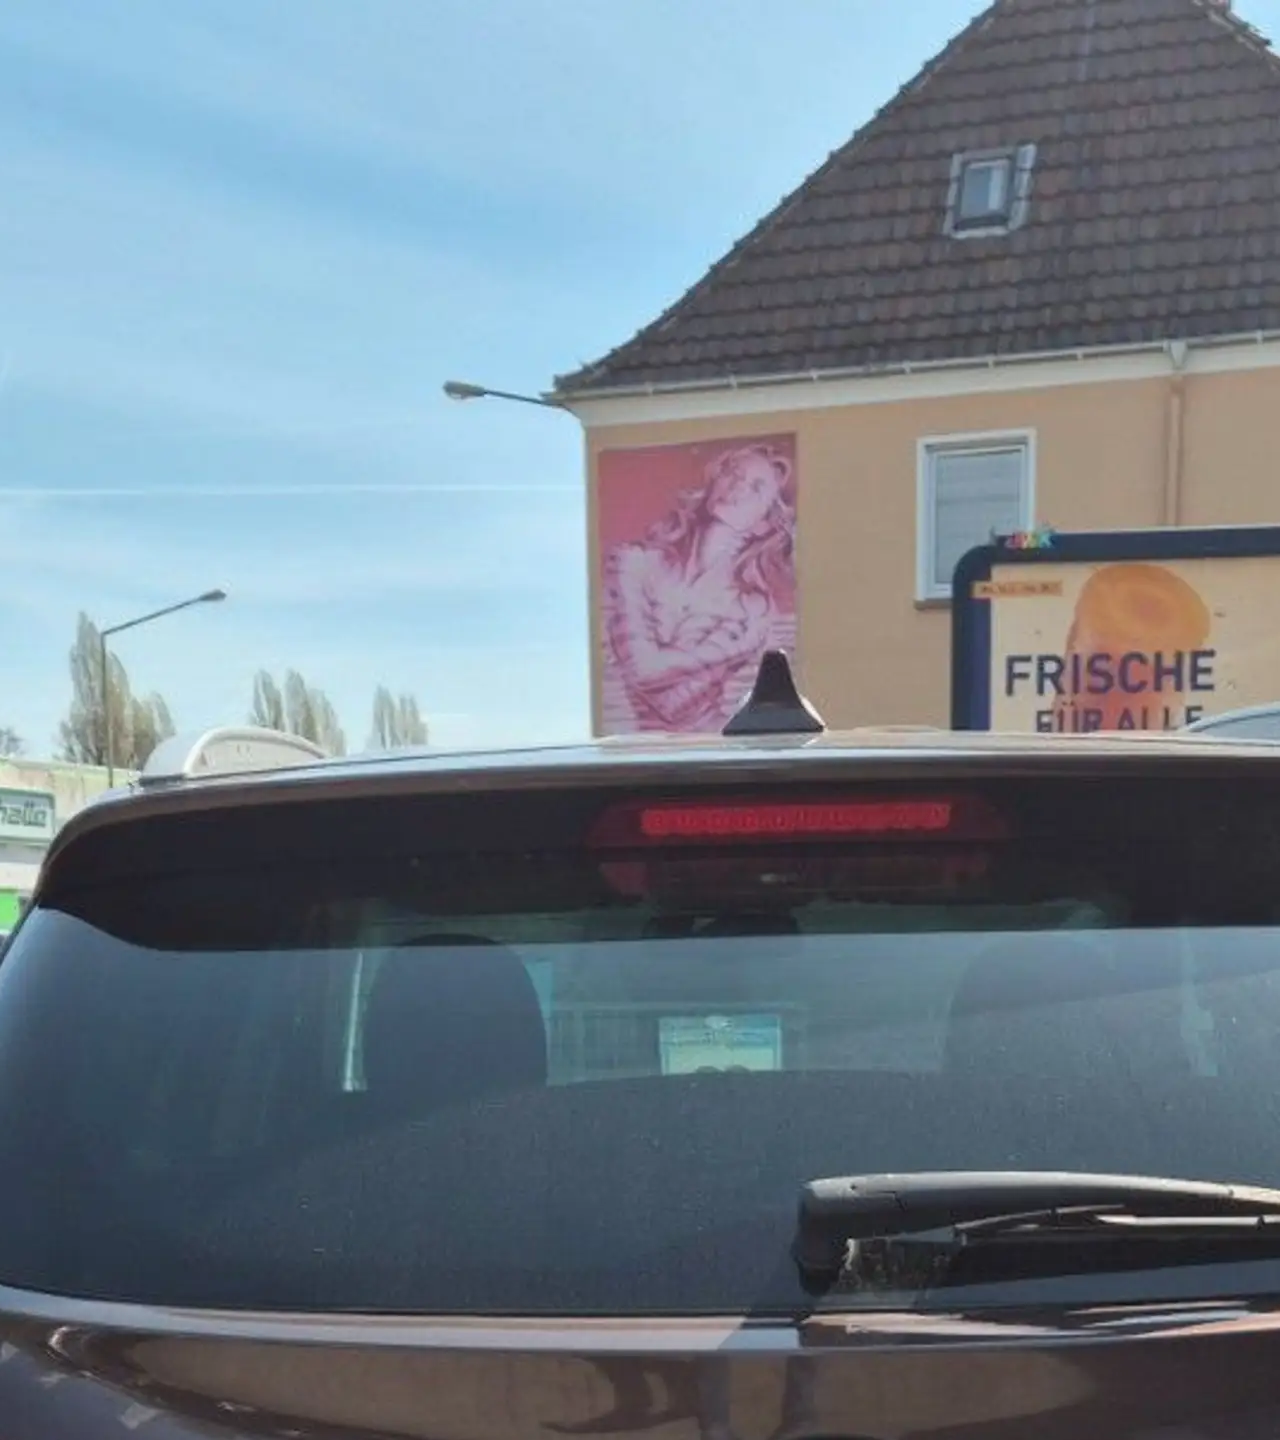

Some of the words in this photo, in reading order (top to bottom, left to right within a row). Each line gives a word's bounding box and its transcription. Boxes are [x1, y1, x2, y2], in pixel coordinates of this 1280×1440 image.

[1004, 649, 1216, 697] FRISCHE
[1035, 701, 1103, 733] FÜR
[1116, 705, 1204, 733] ALLE
